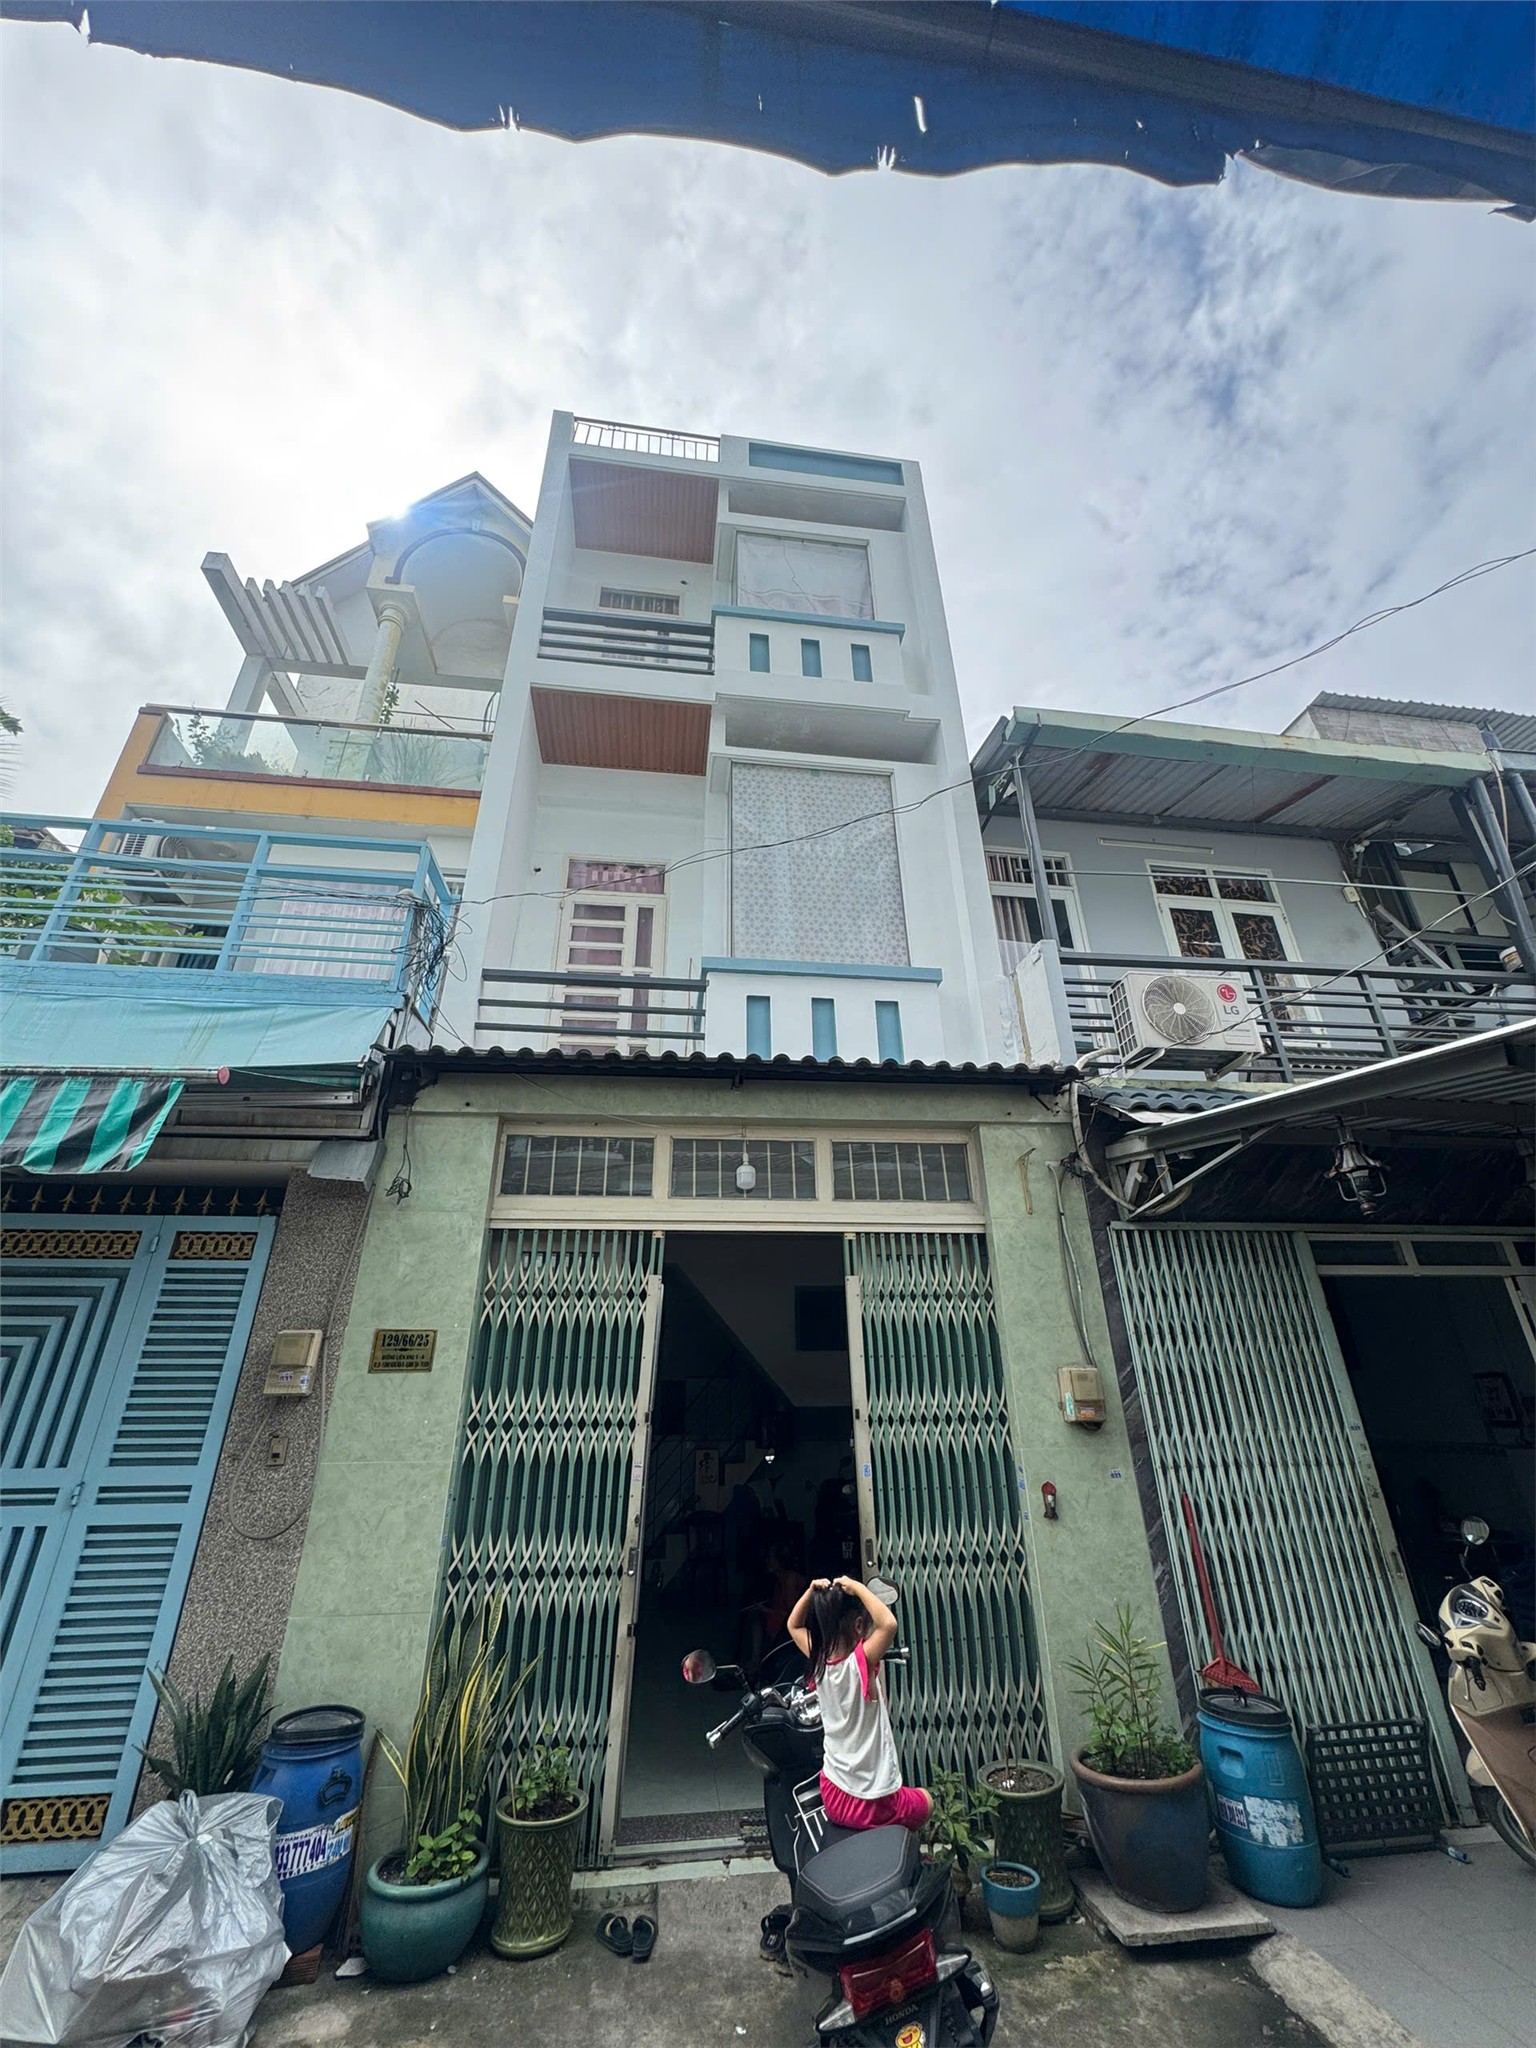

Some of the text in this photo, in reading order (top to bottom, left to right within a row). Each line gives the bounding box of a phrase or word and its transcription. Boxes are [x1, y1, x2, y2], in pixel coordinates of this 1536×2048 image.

[1223, 1004, 1240, 1016] LG
[382, 1333, 430, 1347] 129/66/25
[884, 2004, 919, 2026] HONDA
